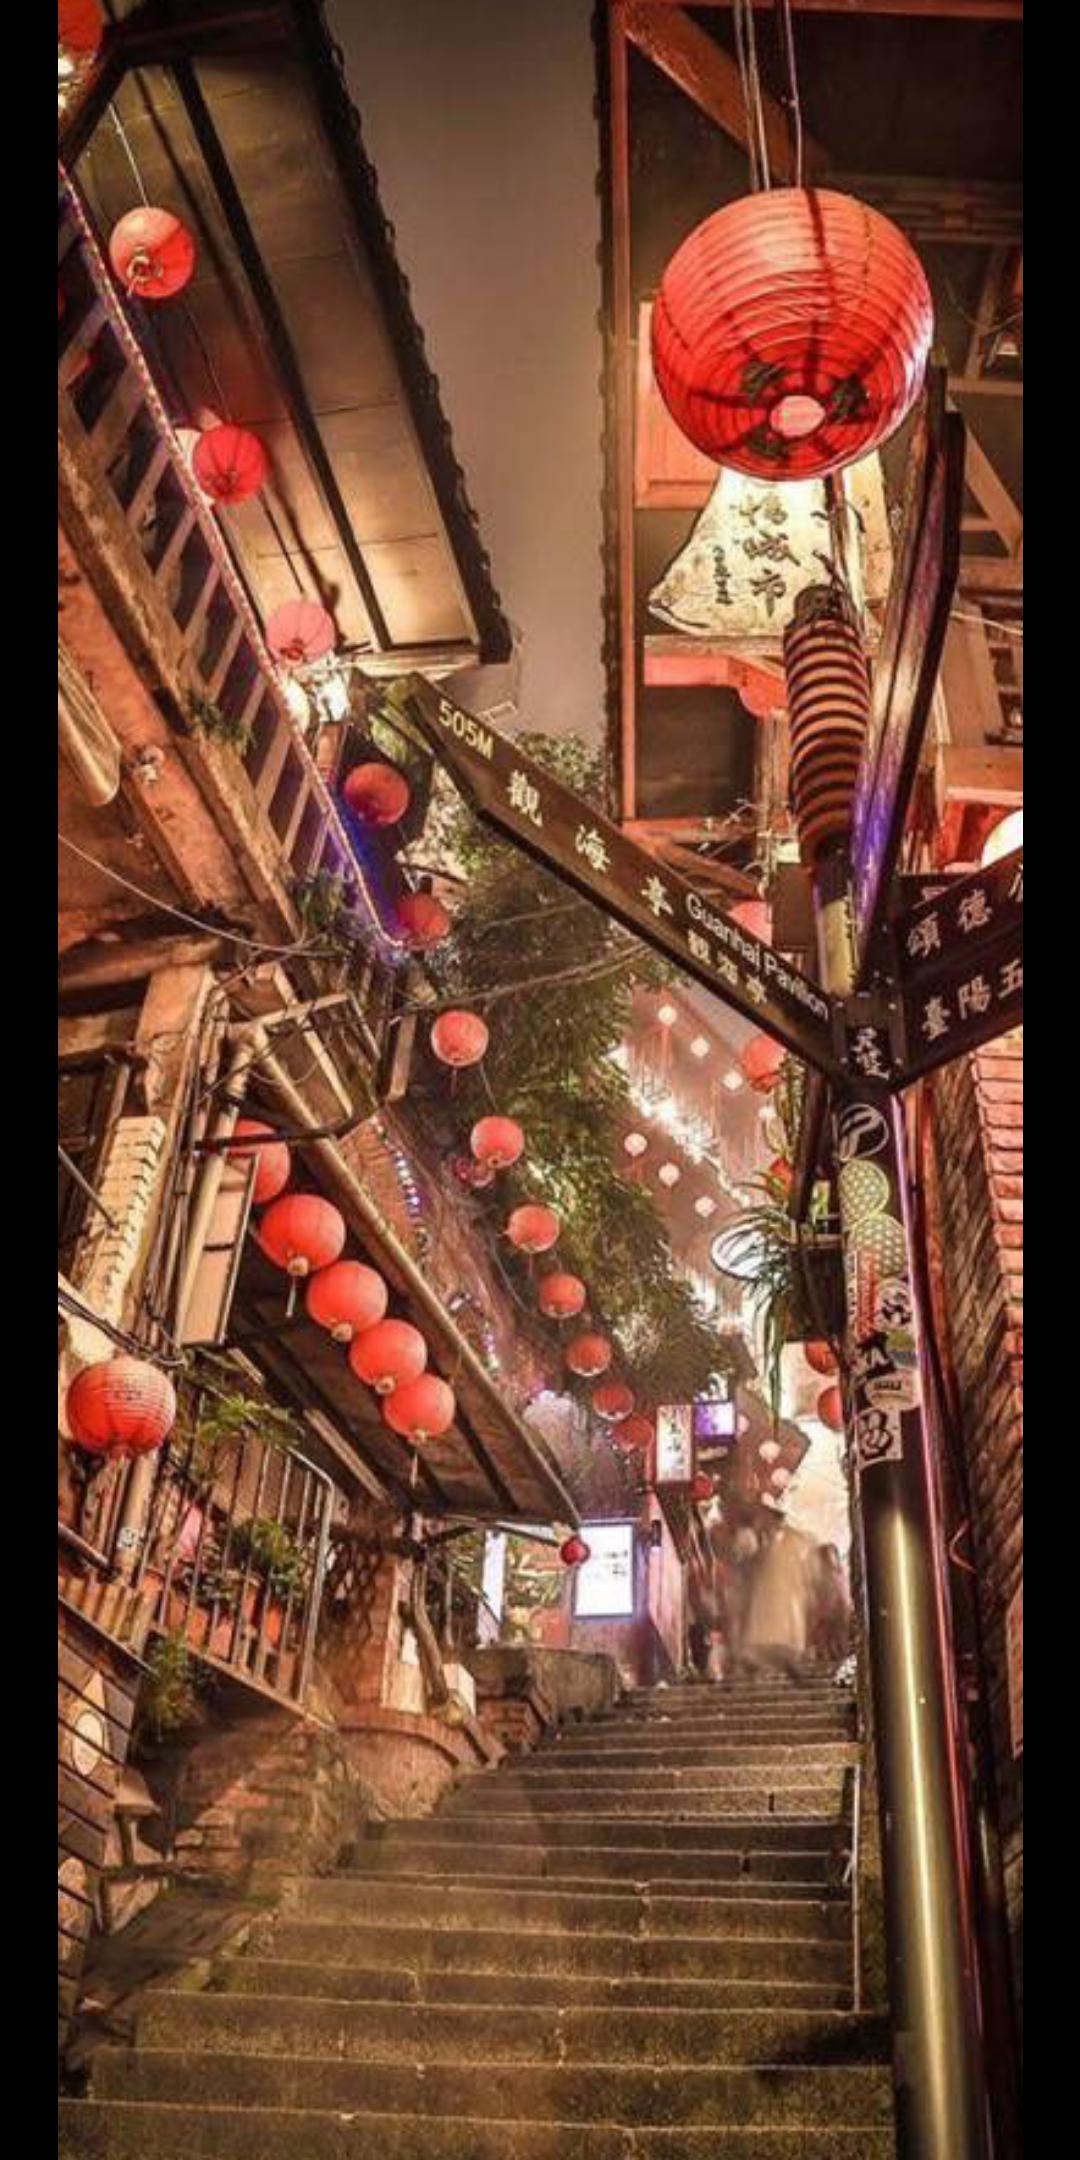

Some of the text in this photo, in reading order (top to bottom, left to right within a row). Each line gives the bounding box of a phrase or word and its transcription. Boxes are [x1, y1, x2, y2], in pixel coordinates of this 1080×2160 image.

[437, 700, 494, 760] 505M
[685, 892, 829, 1022] Guanhai Pavilion
